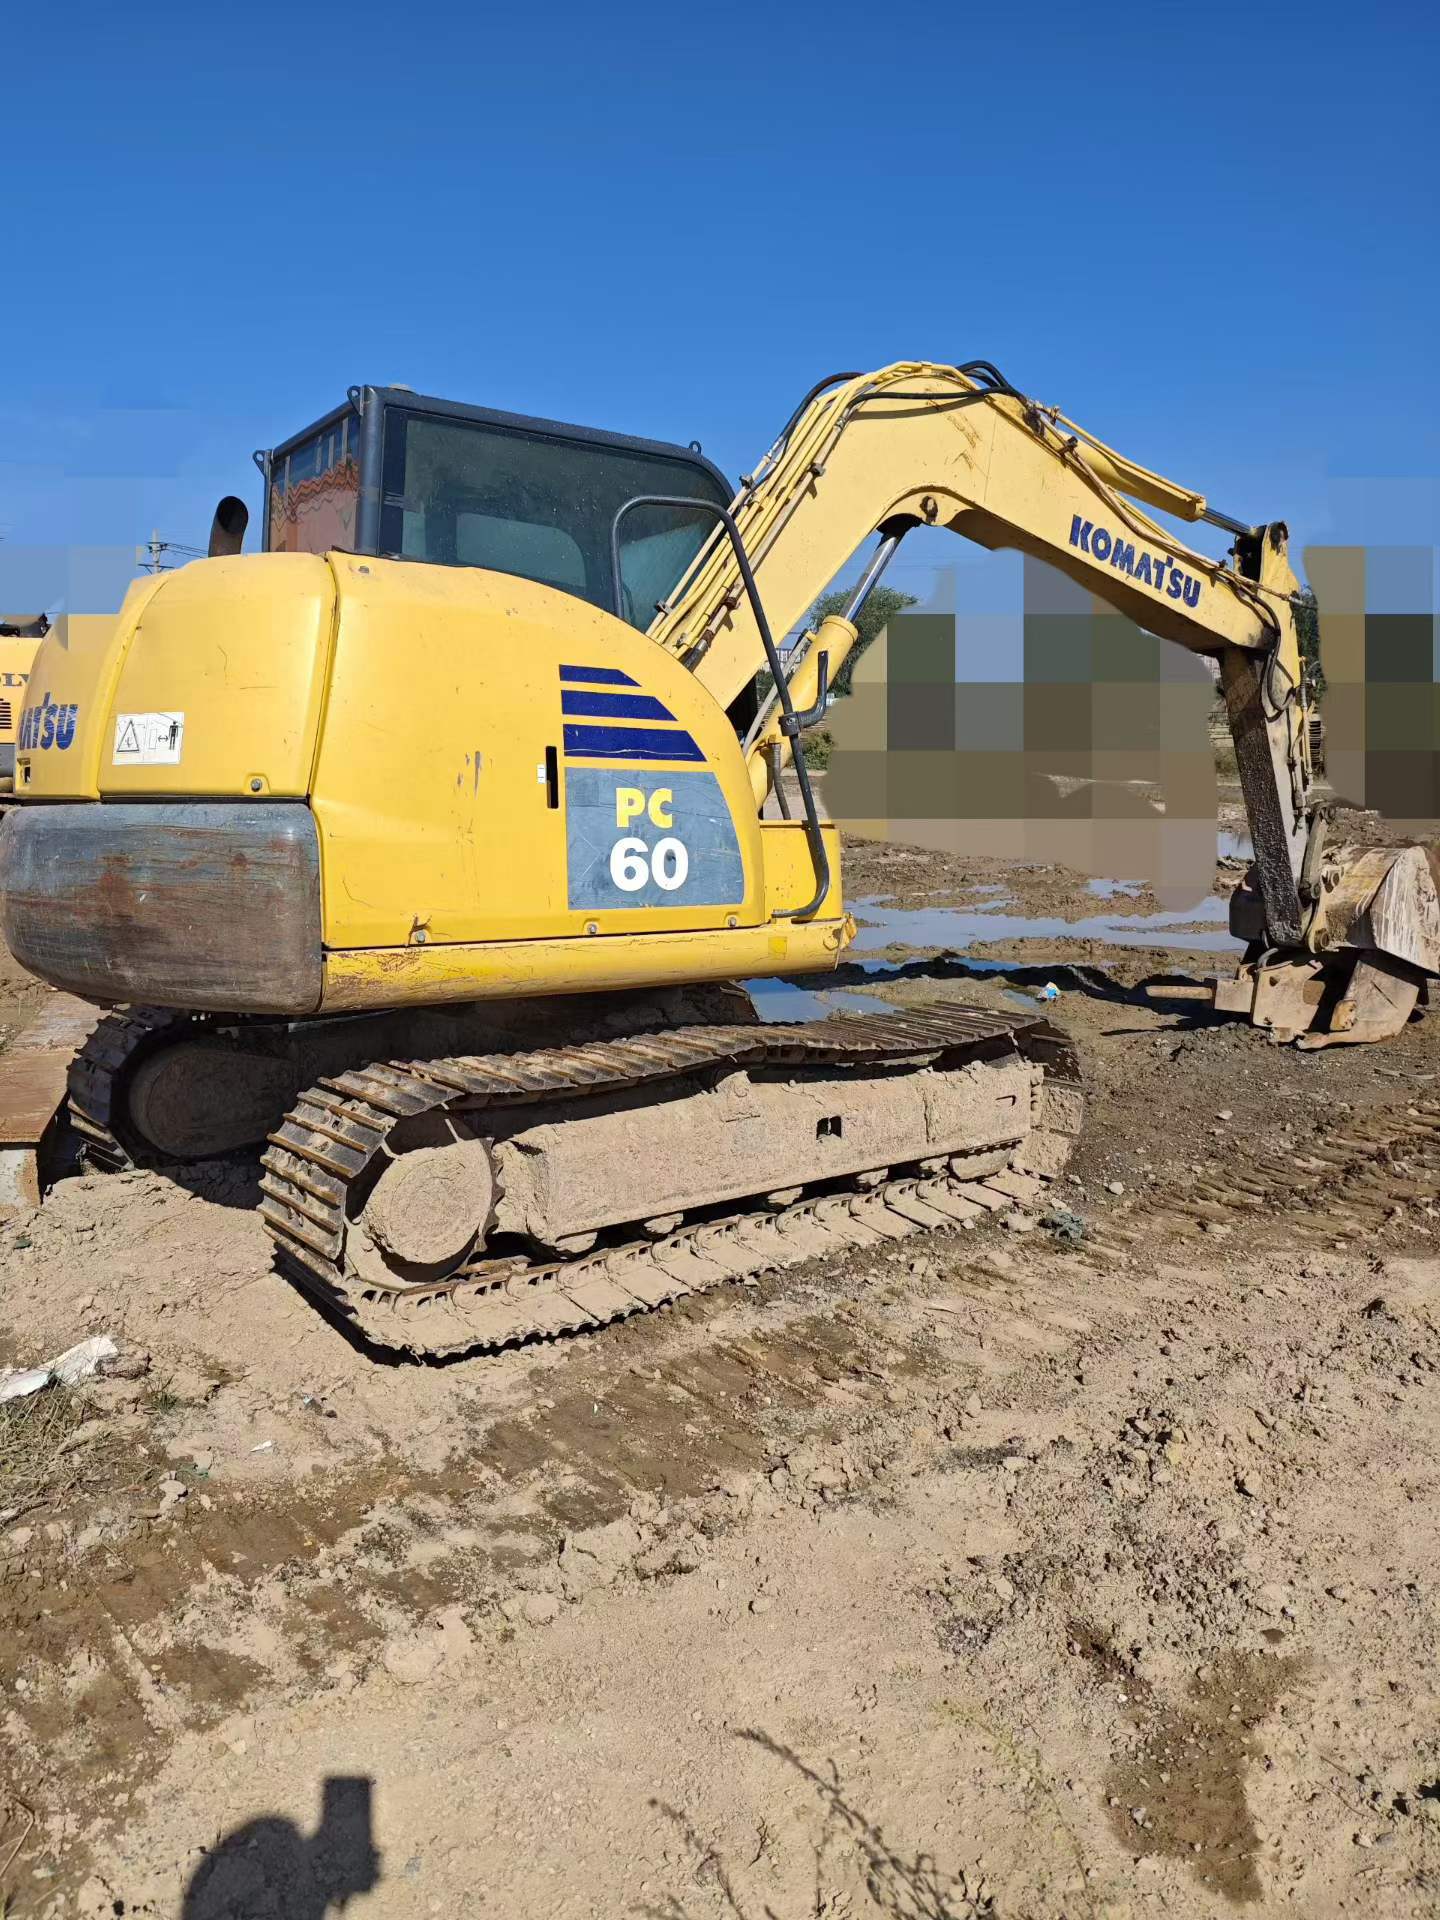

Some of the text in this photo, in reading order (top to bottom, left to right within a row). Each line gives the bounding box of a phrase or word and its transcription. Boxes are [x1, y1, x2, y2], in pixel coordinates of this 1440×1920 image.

[1069, 514, 1201, 608] KOMATSU
[19, 692, 78, 750] ATSU
[616, 787, 673, 829] PC
[610, 837, 689, 891] 60
